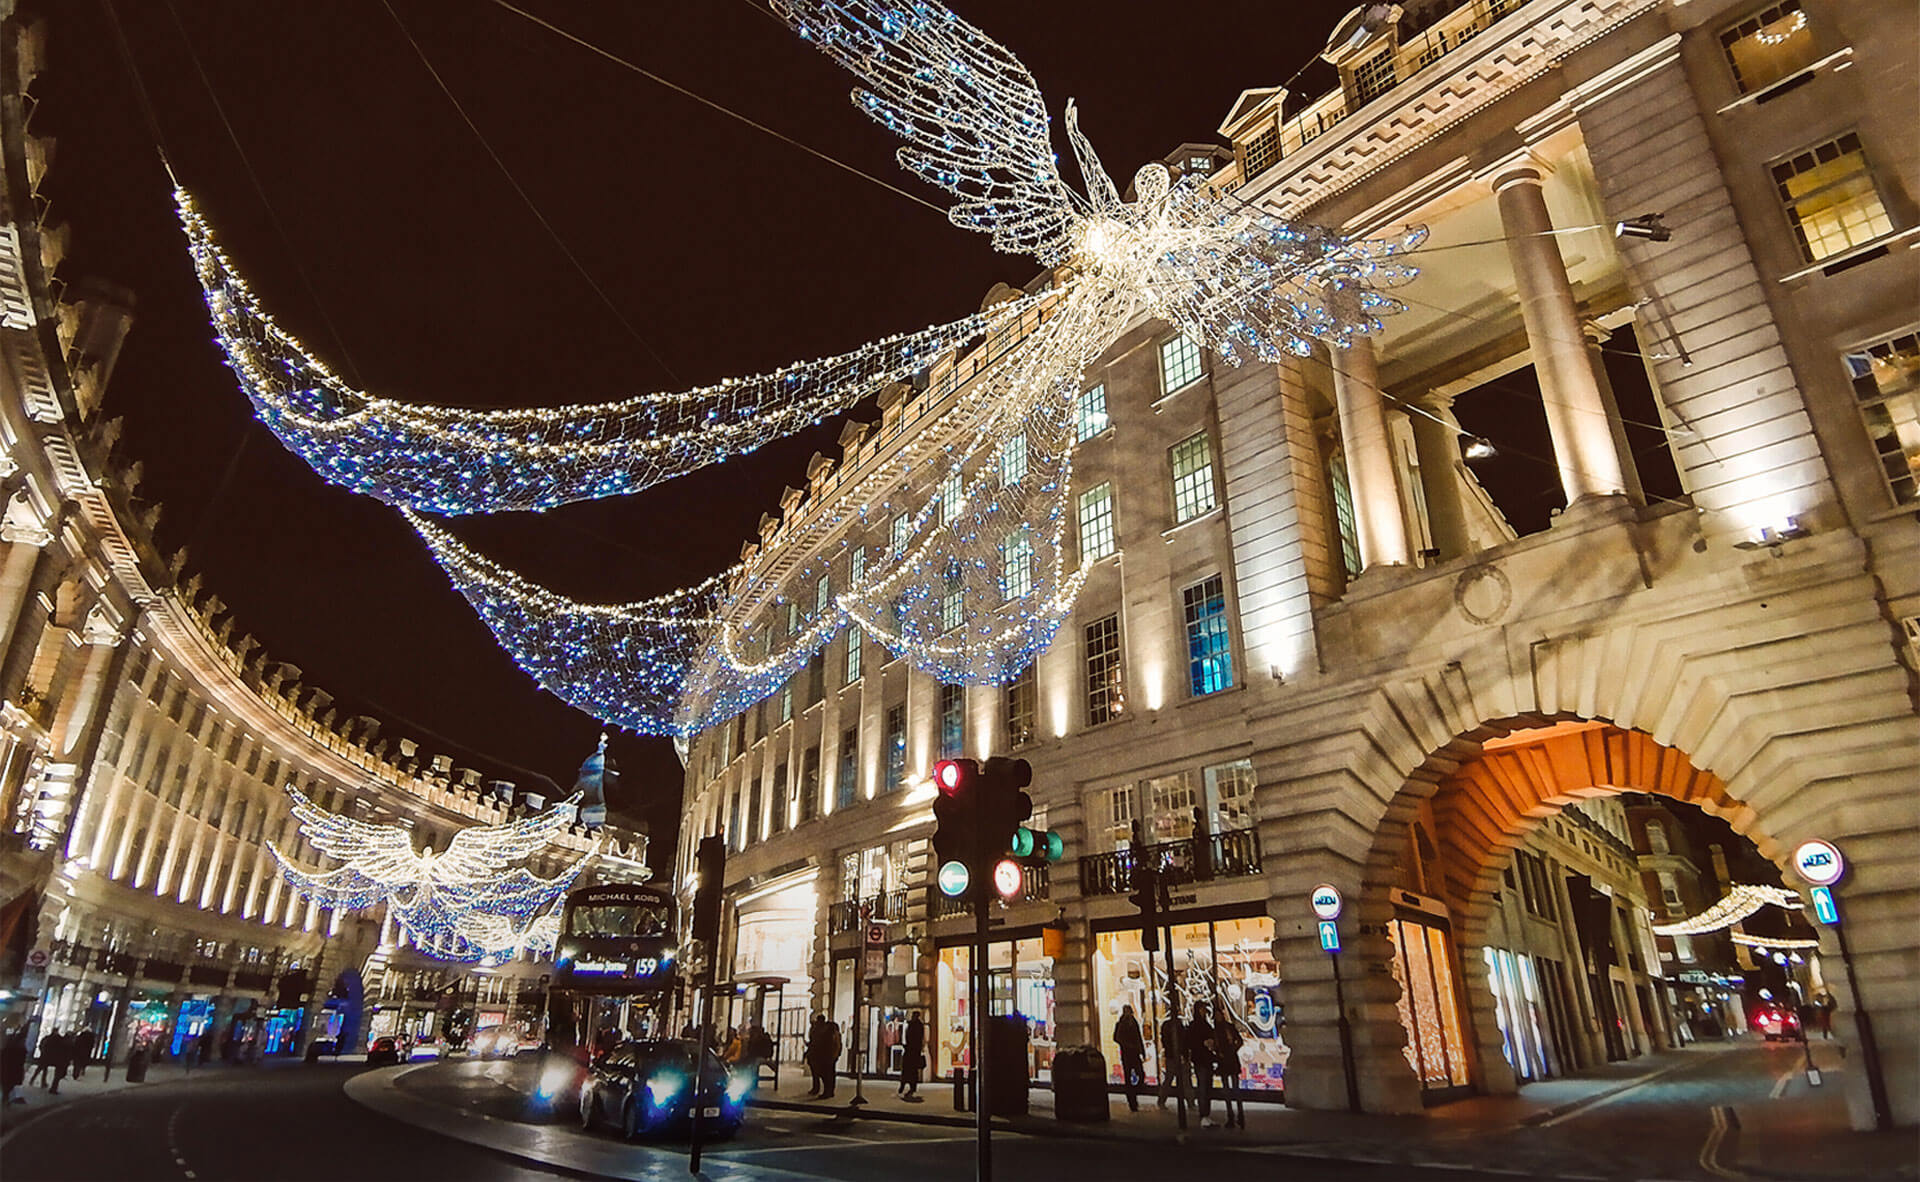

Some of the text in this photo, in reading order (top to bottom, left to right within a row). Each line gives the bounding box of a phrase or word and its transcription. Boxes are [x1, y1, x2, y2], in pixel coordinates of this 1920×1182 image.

[588, 893, 660, 904] MICHAEL KORS
[636, 958, 657, 974] 159
